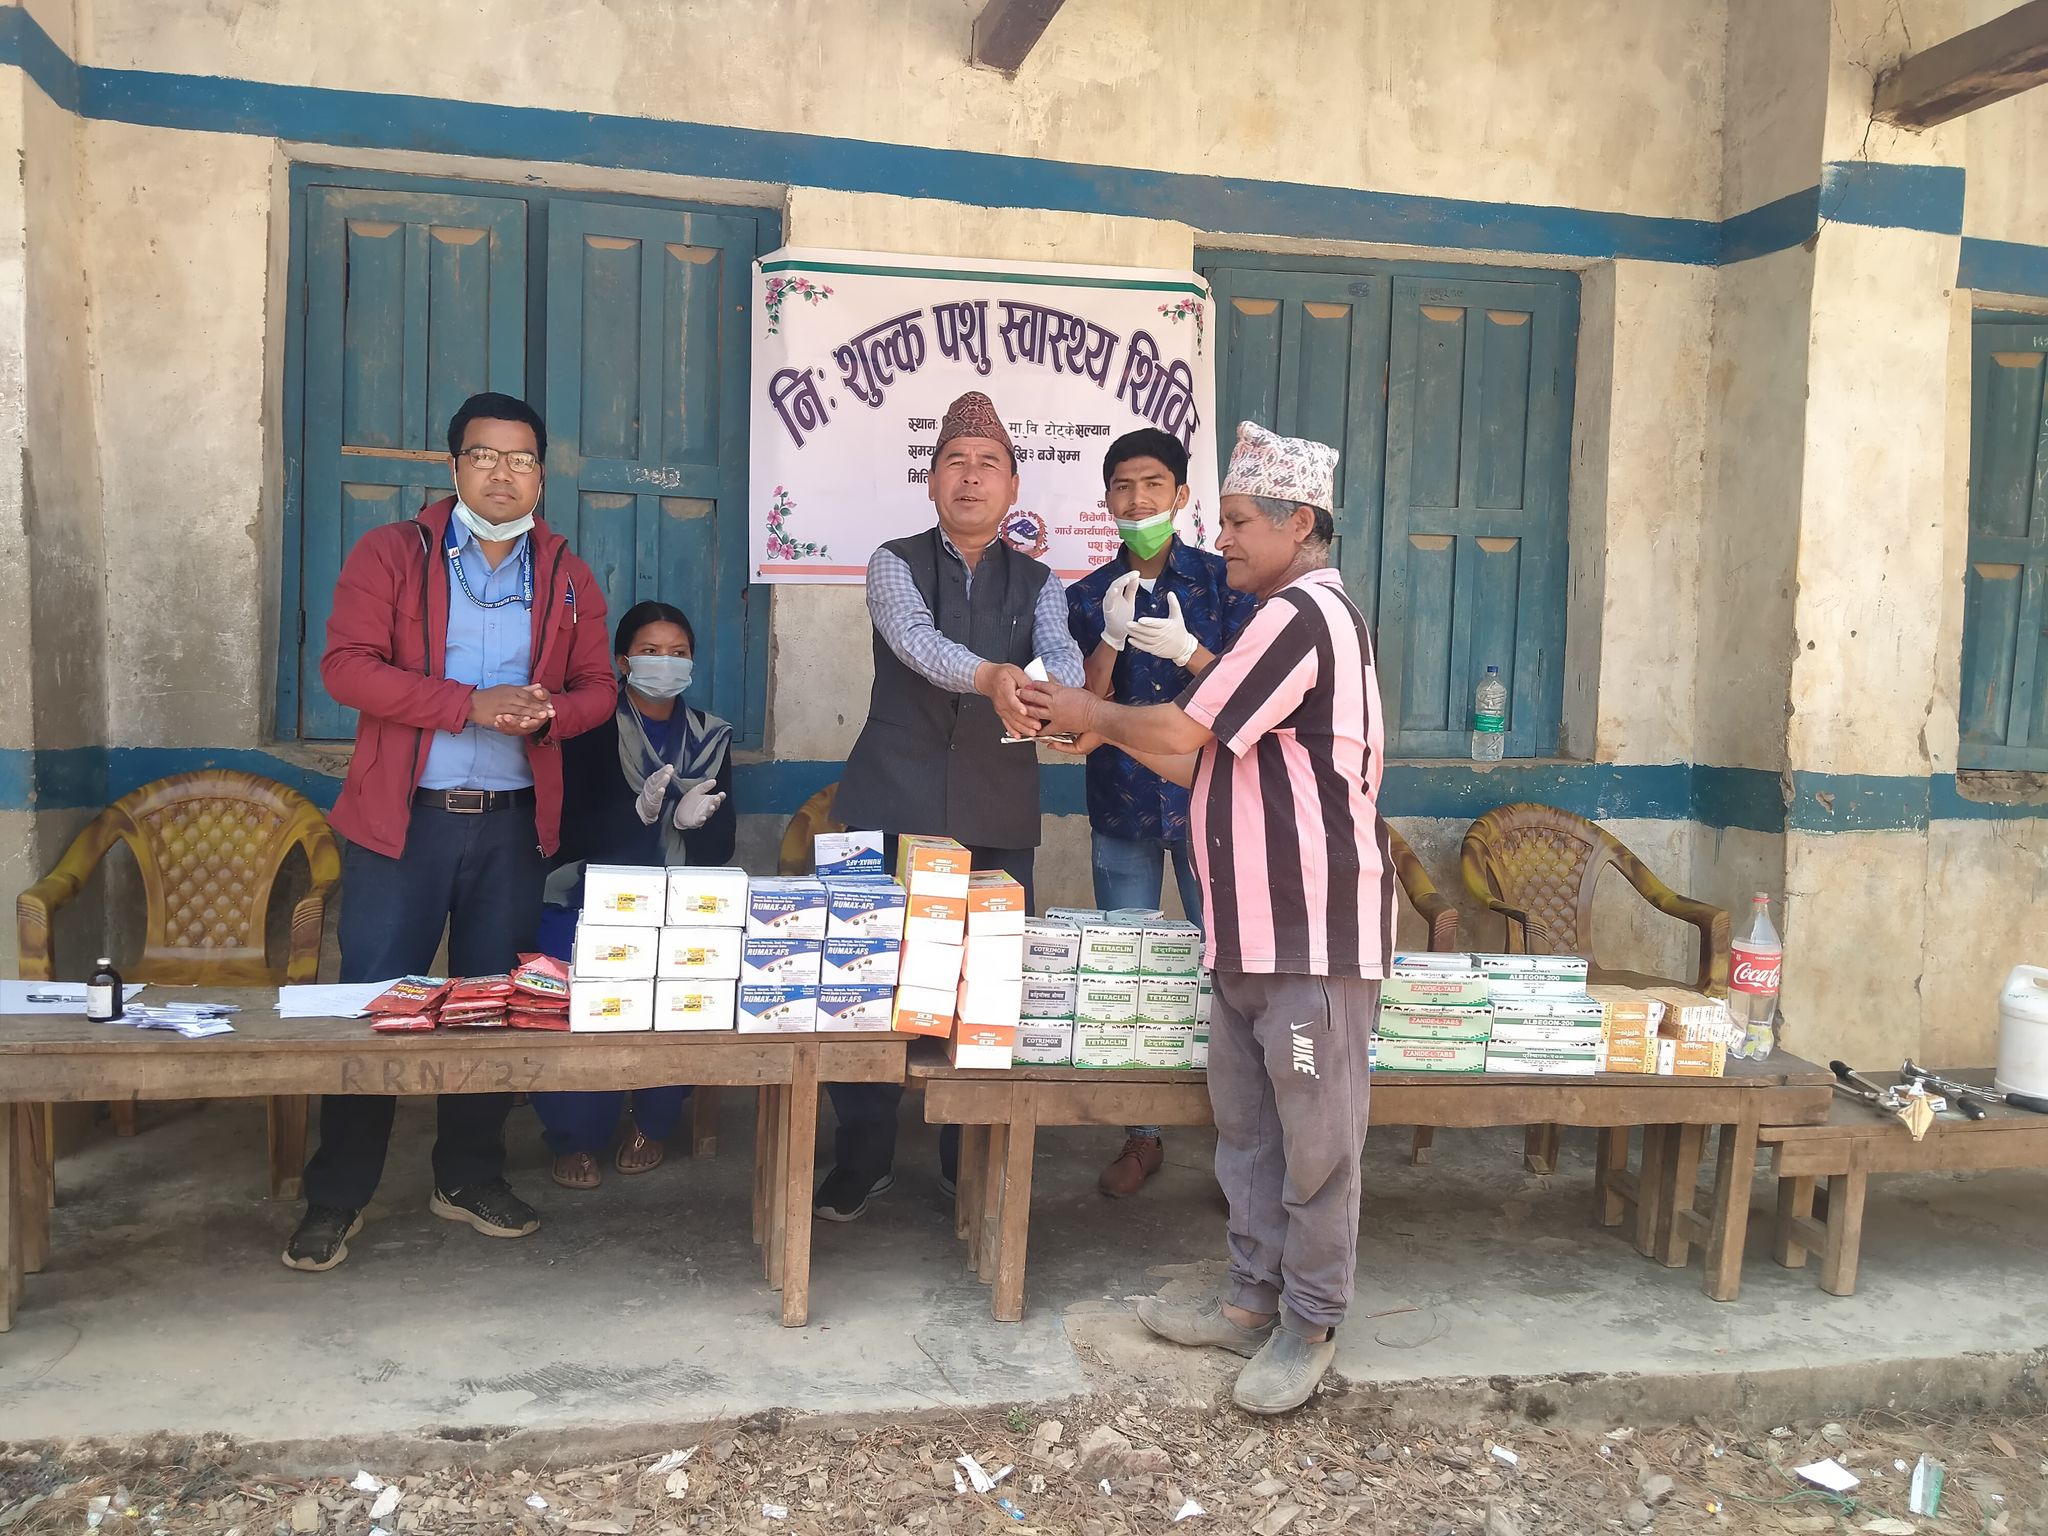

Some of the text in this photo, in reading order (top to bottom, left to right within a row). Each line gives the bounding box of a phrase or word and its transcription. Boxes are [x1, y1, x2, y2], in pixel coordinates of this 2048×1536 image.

[833, 309, 926, 408] शुल्क
[931, 300, 992, 376] पशु
[998, 300, 1121, 389] स्वास्थ्य
[752, 902, 796, 911] RUMAX-AFS
[833, 902, 875, 910] RUMAX-AFS
[747, 948, 789, 956] RUMAX-AFS
[827, 947, 869, 955] RUMAX-AFS
[1033, 946, 1066, 954] COTRIMOX
[1094, 945, 1132, 953] TETRACLIN
[743, 995, 785, 1003] RUMAX-AFS
[820, 995, 862, 1003] RUMAX-AFS
[1148, 994, 1188, 1002] TETRACLIN
[1292, 1032, 1316, 1075] NIKE
